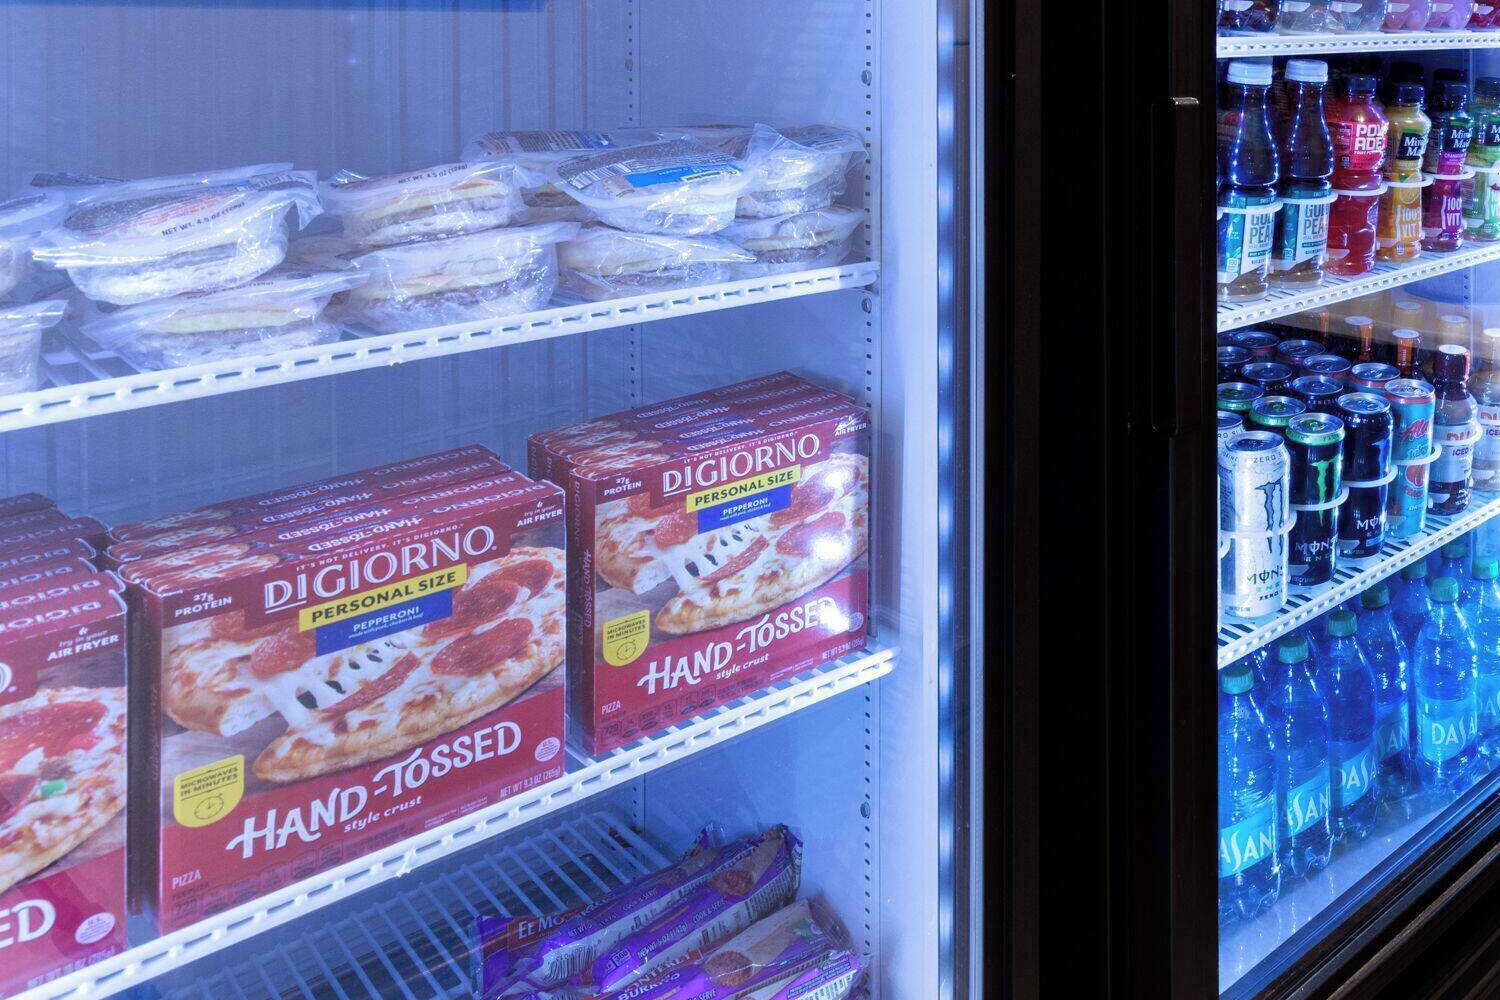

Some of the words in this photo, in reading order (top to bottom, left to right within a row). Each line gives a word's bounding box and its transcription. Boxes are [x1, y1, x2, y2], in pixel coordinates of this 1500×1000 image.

[849, 422, 868, 434] FRYER
[663, 434, 820, 495] DIGIORNO
[604, 481, 642, 496] PROTEIN
[616, 477, 630, 485] 27g
[695, 482, 764, 506] PERSONAL
[767, 470, 793, 486] SIZE
[517, 516, 533, 527] AIR
[534, 509, 563, 523] FRYER
[723, 498, 769, 516] PEPPERONI
[264, 525, 496, 614] DIGIORNO
[174, 596, 232, 617] PROTEIN
[193, 592, 213, 602] 27g
[312, 585, 414, 623] PERSONAL
[418, 571, 457, 593] SIZE
[353, 606, 420, 632] PEPPERONI
[607, 619, 646, 635] MICROWAVES
[615, 625, 646, 639] MINUTES
[47, 646, 73, 661] AIR
[75, 634, 120, 653] FRYER
[716, 664, 741, 681] style
[742, 653, 769, 670] crust
[602, 701, 621, 715] PIZZA
[180, 766, 238, 790] MICROWAVES
[180, 789, 191, 797] IN
[192, 773, 238, 793] MINUTES
[226, 721, 522, 859] HAND-TOSSED
[500, 786, 512, 797] NET
[513, 783, 522, 793] WT
[344, 807, 381, 834] style
[383, 796, 422, 822] crust
[1219, 824, 1276, 872] ASANI
[172, 870, 201, 888] PIZZA
